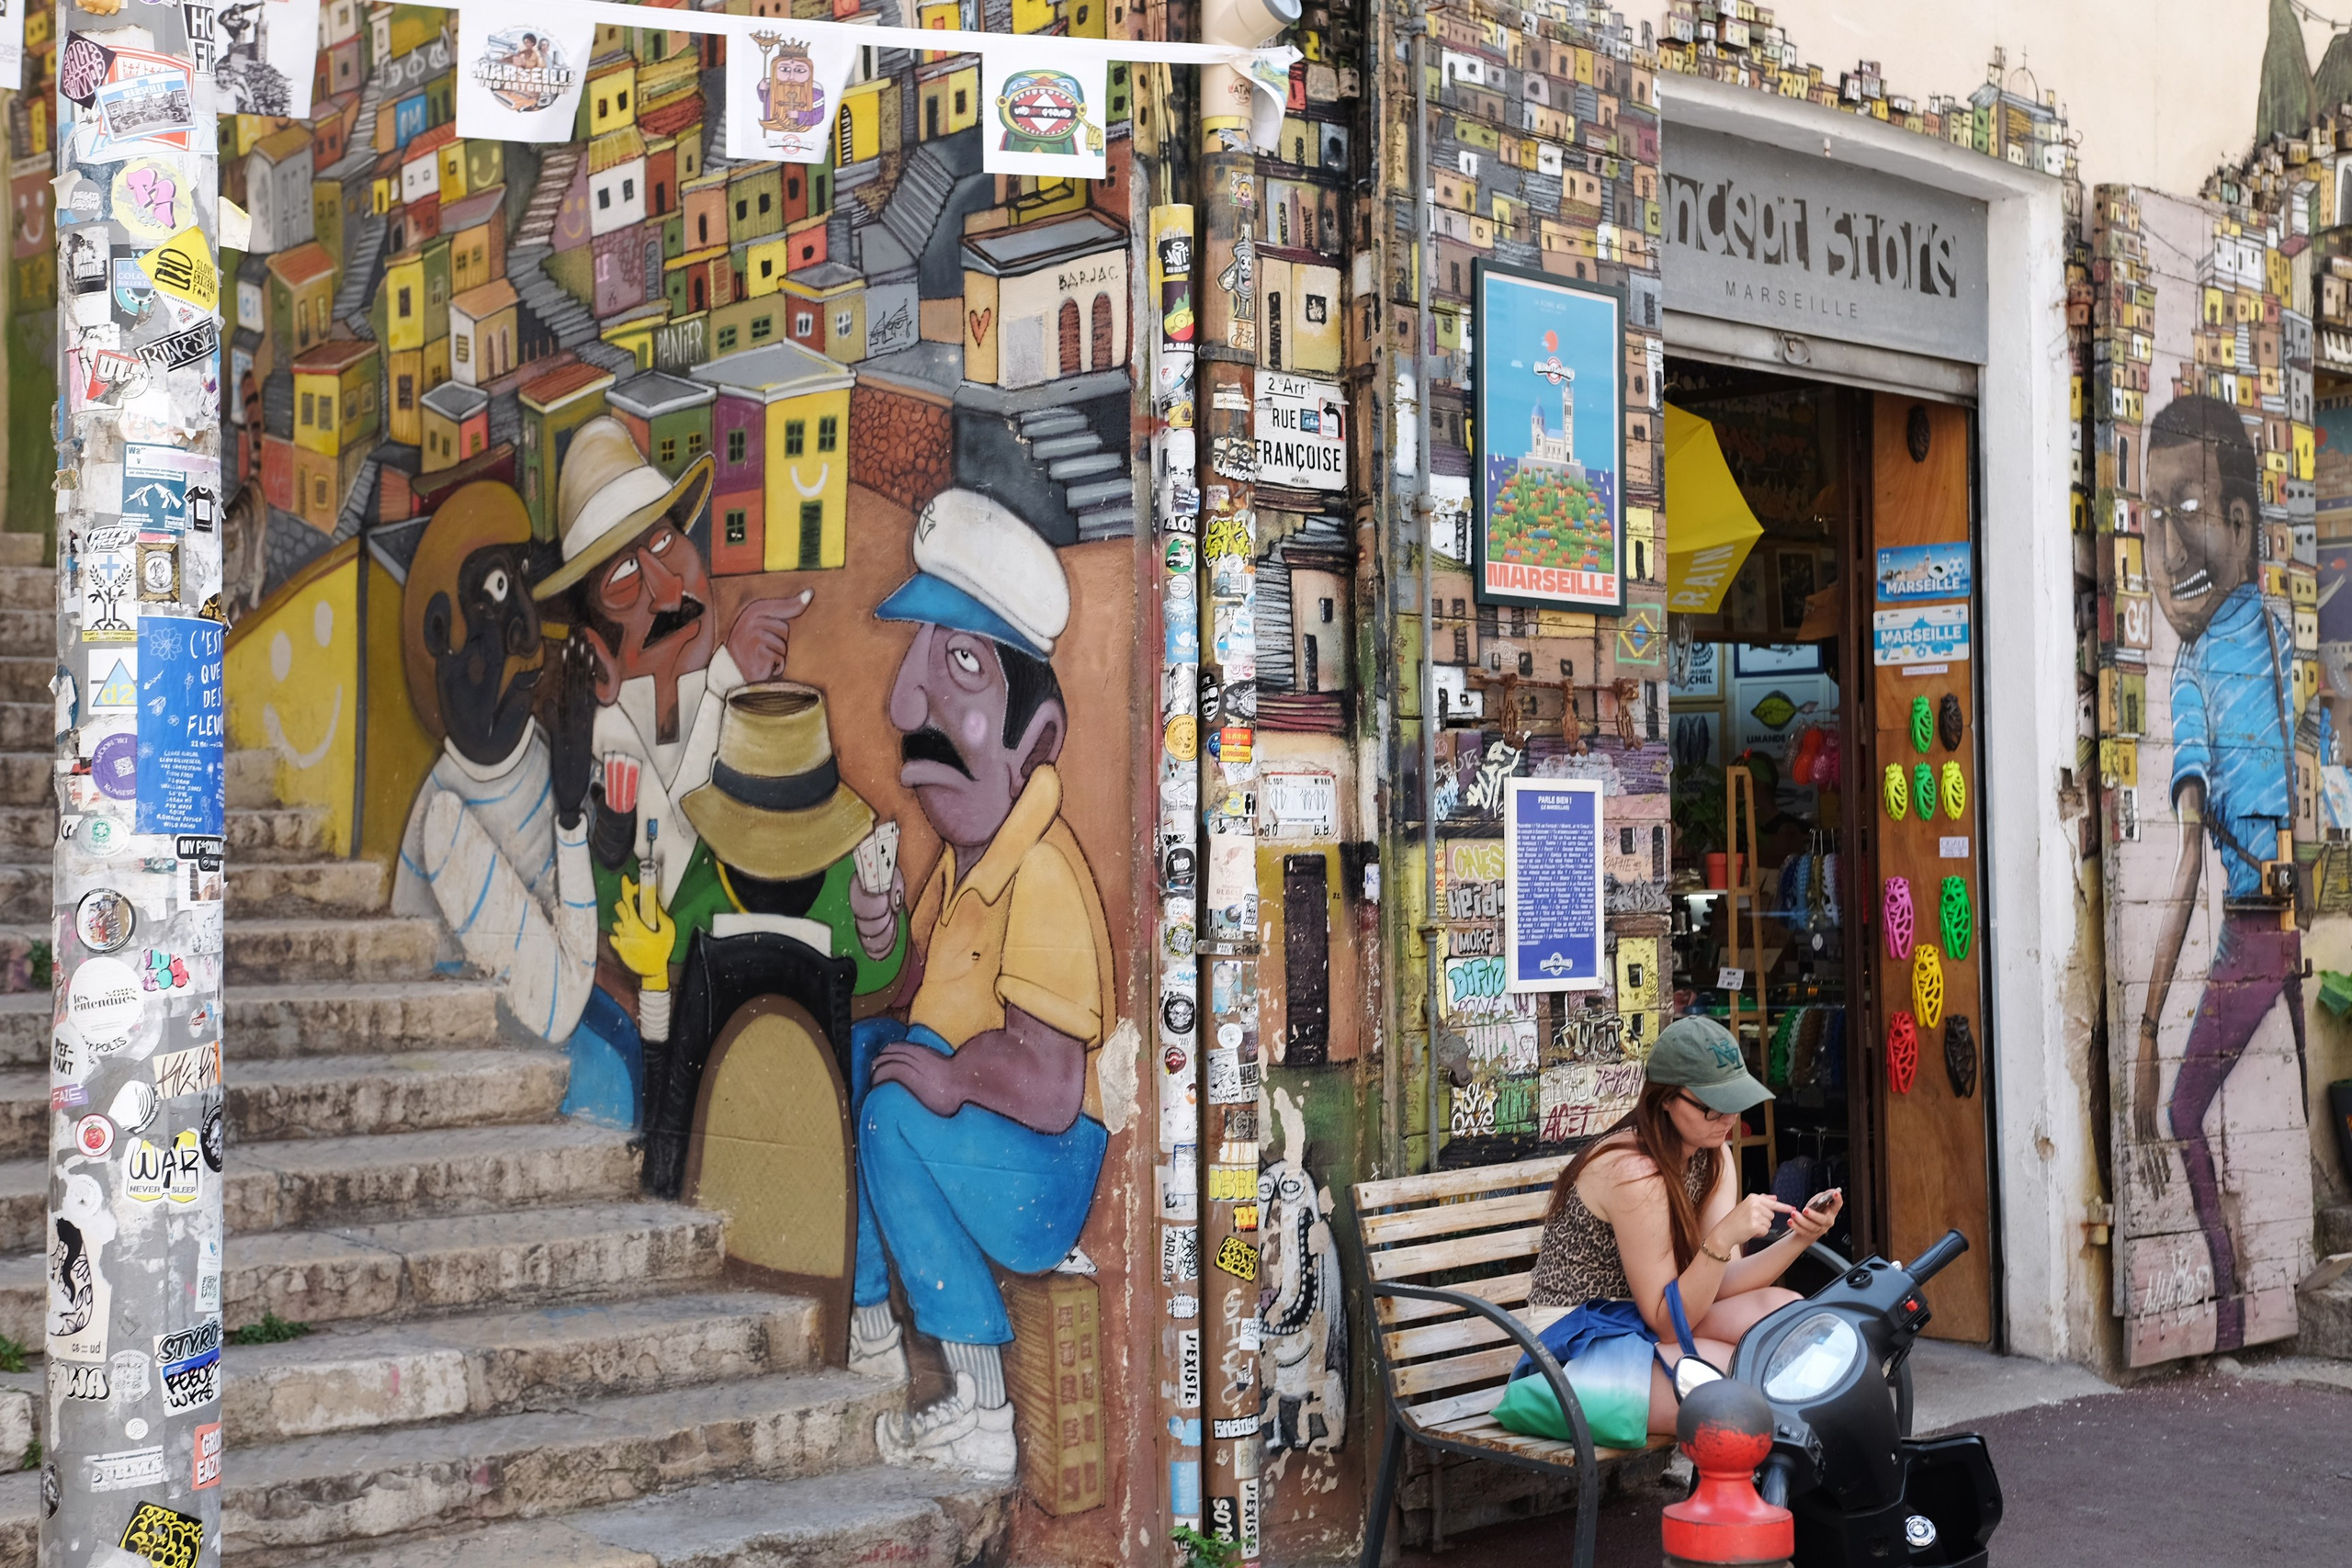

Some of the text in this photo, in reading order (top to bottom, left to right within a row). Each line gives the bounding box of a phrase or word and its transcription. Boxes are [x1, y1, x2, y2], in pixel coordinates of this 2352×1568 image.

[1057, 265, 1118, 291] BARJAC
[1725, 280, 1858, 320] MARSEILLE
[1272, 407, 1296, 429] RUE
[1255, 438, 1341, 473] FRANÇOISE
[1487, 562, 1615, 598] MARSEILLE
[1885, 577, 1960, 594] MARSEILLE
[1881, 626, 1962, 645] MARSEILLE
[1747, 735, 1785, 744] LIMANDE
[180, 840, 195, 854] MY
[129, 1147, 199, 1187] WAR
[129, 1185, 196, 1193] NEVER SLEEP
[1184, 1335, 1197, 1405] J'EXISTE.
[1245, 1484, 1257, 1556] J'EXISTE.
